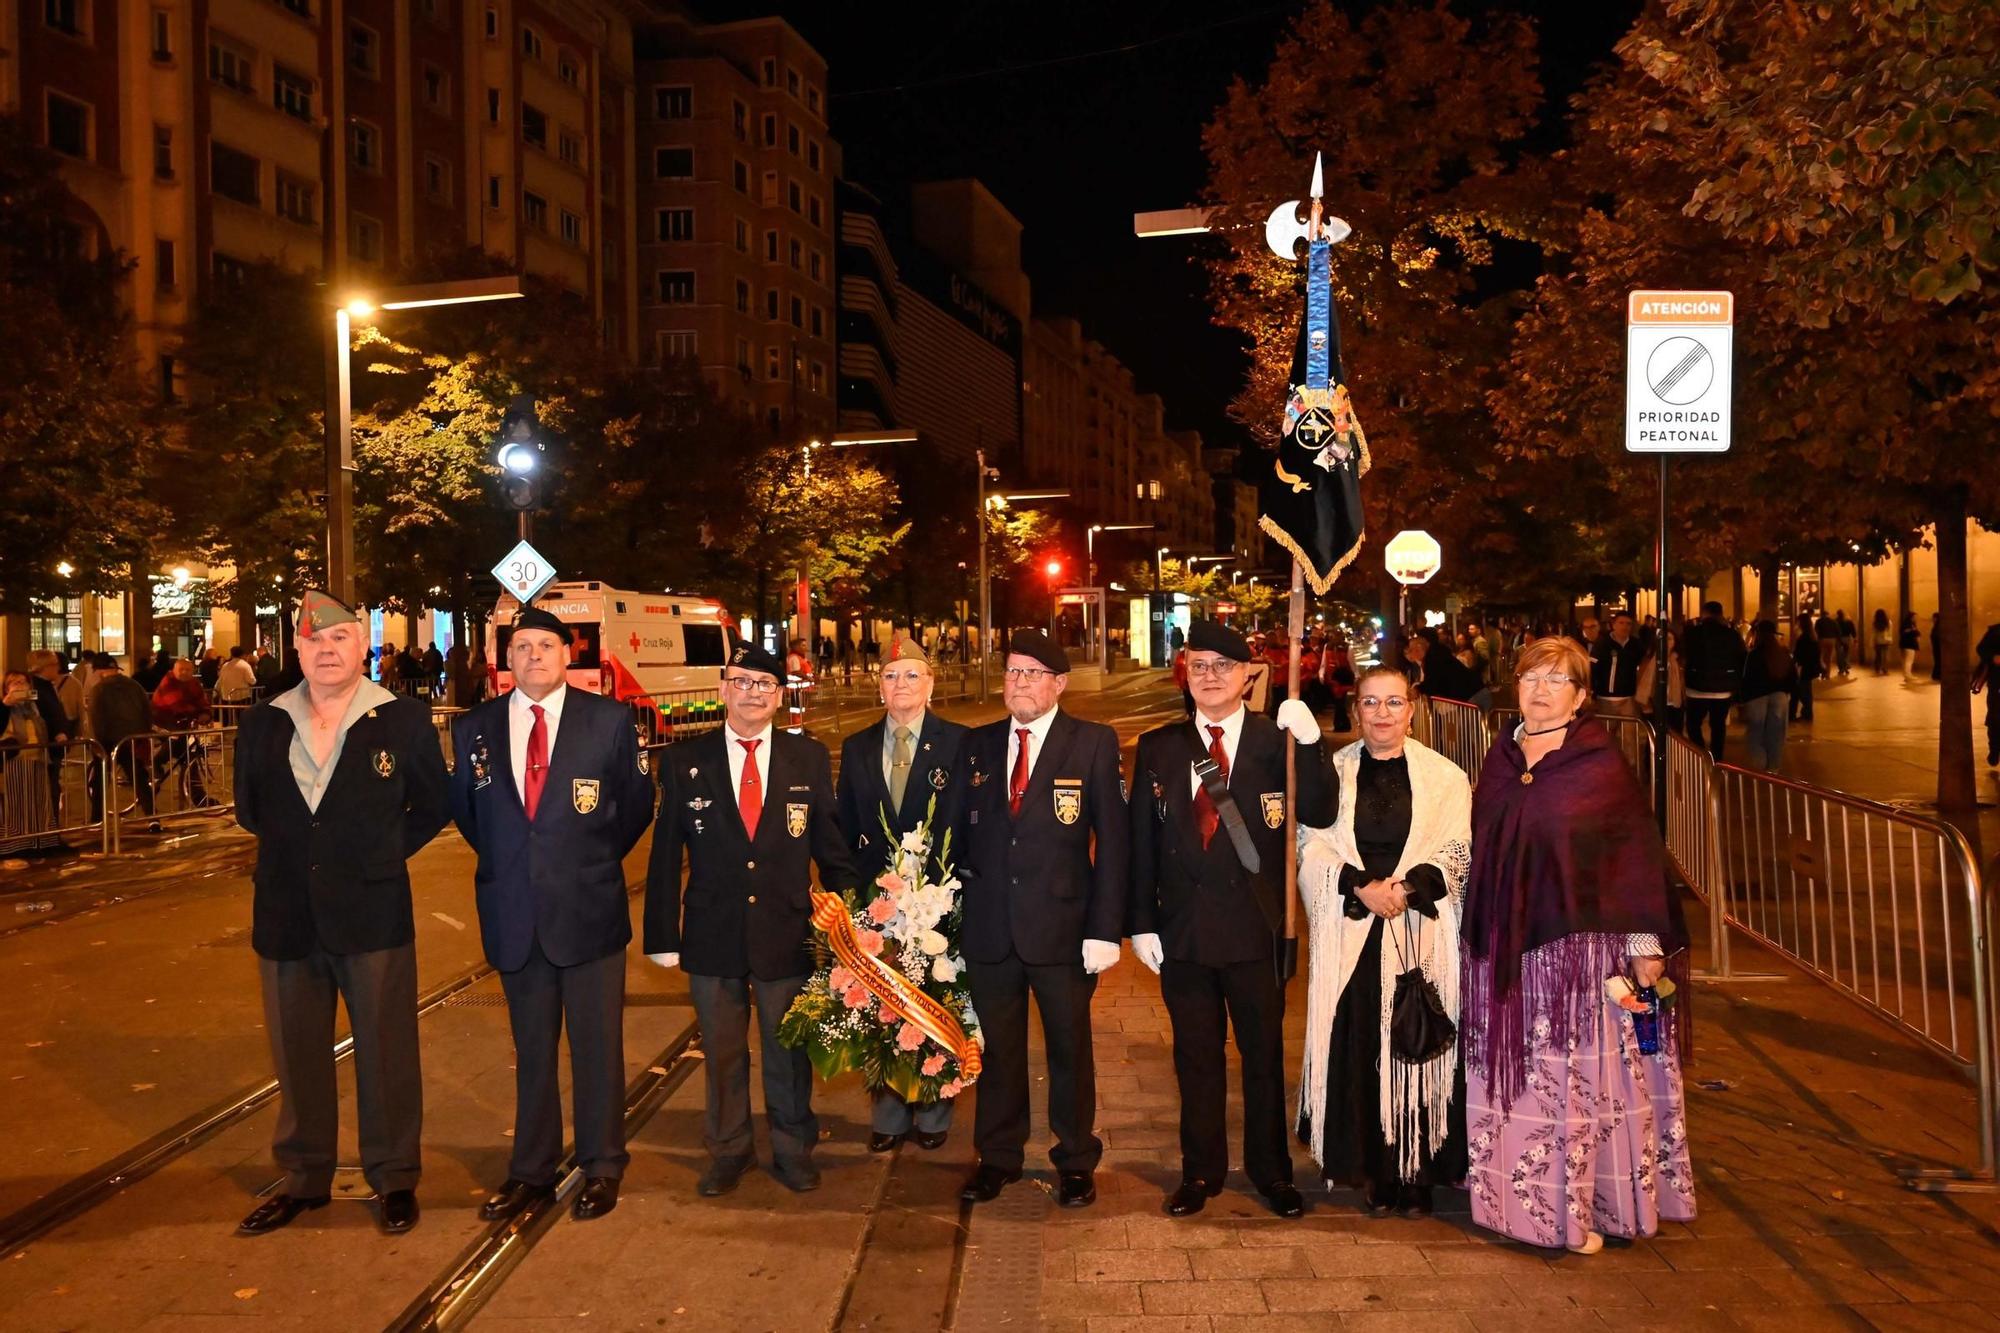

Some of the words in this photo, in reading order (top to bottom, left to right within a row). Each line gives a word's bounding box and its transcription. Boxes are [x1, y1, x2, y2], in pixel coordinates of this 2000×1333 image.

[1641, 301, 1721, 314] ATENCIÓN
[1639, 412, 1720, 423] PRIORIDAD
[1640, 430, 1719, 442] PEATONAL
[511, 562, 537, 581] 30
[643, 638, 658, 648] Cruz
[659, 637, 674, 651] Roja
[850, 961, 861, 973] DE
[863, 973, 908, 1010] ARAGON
[874, 966, 949, 1026] PARACAIDISTAS
